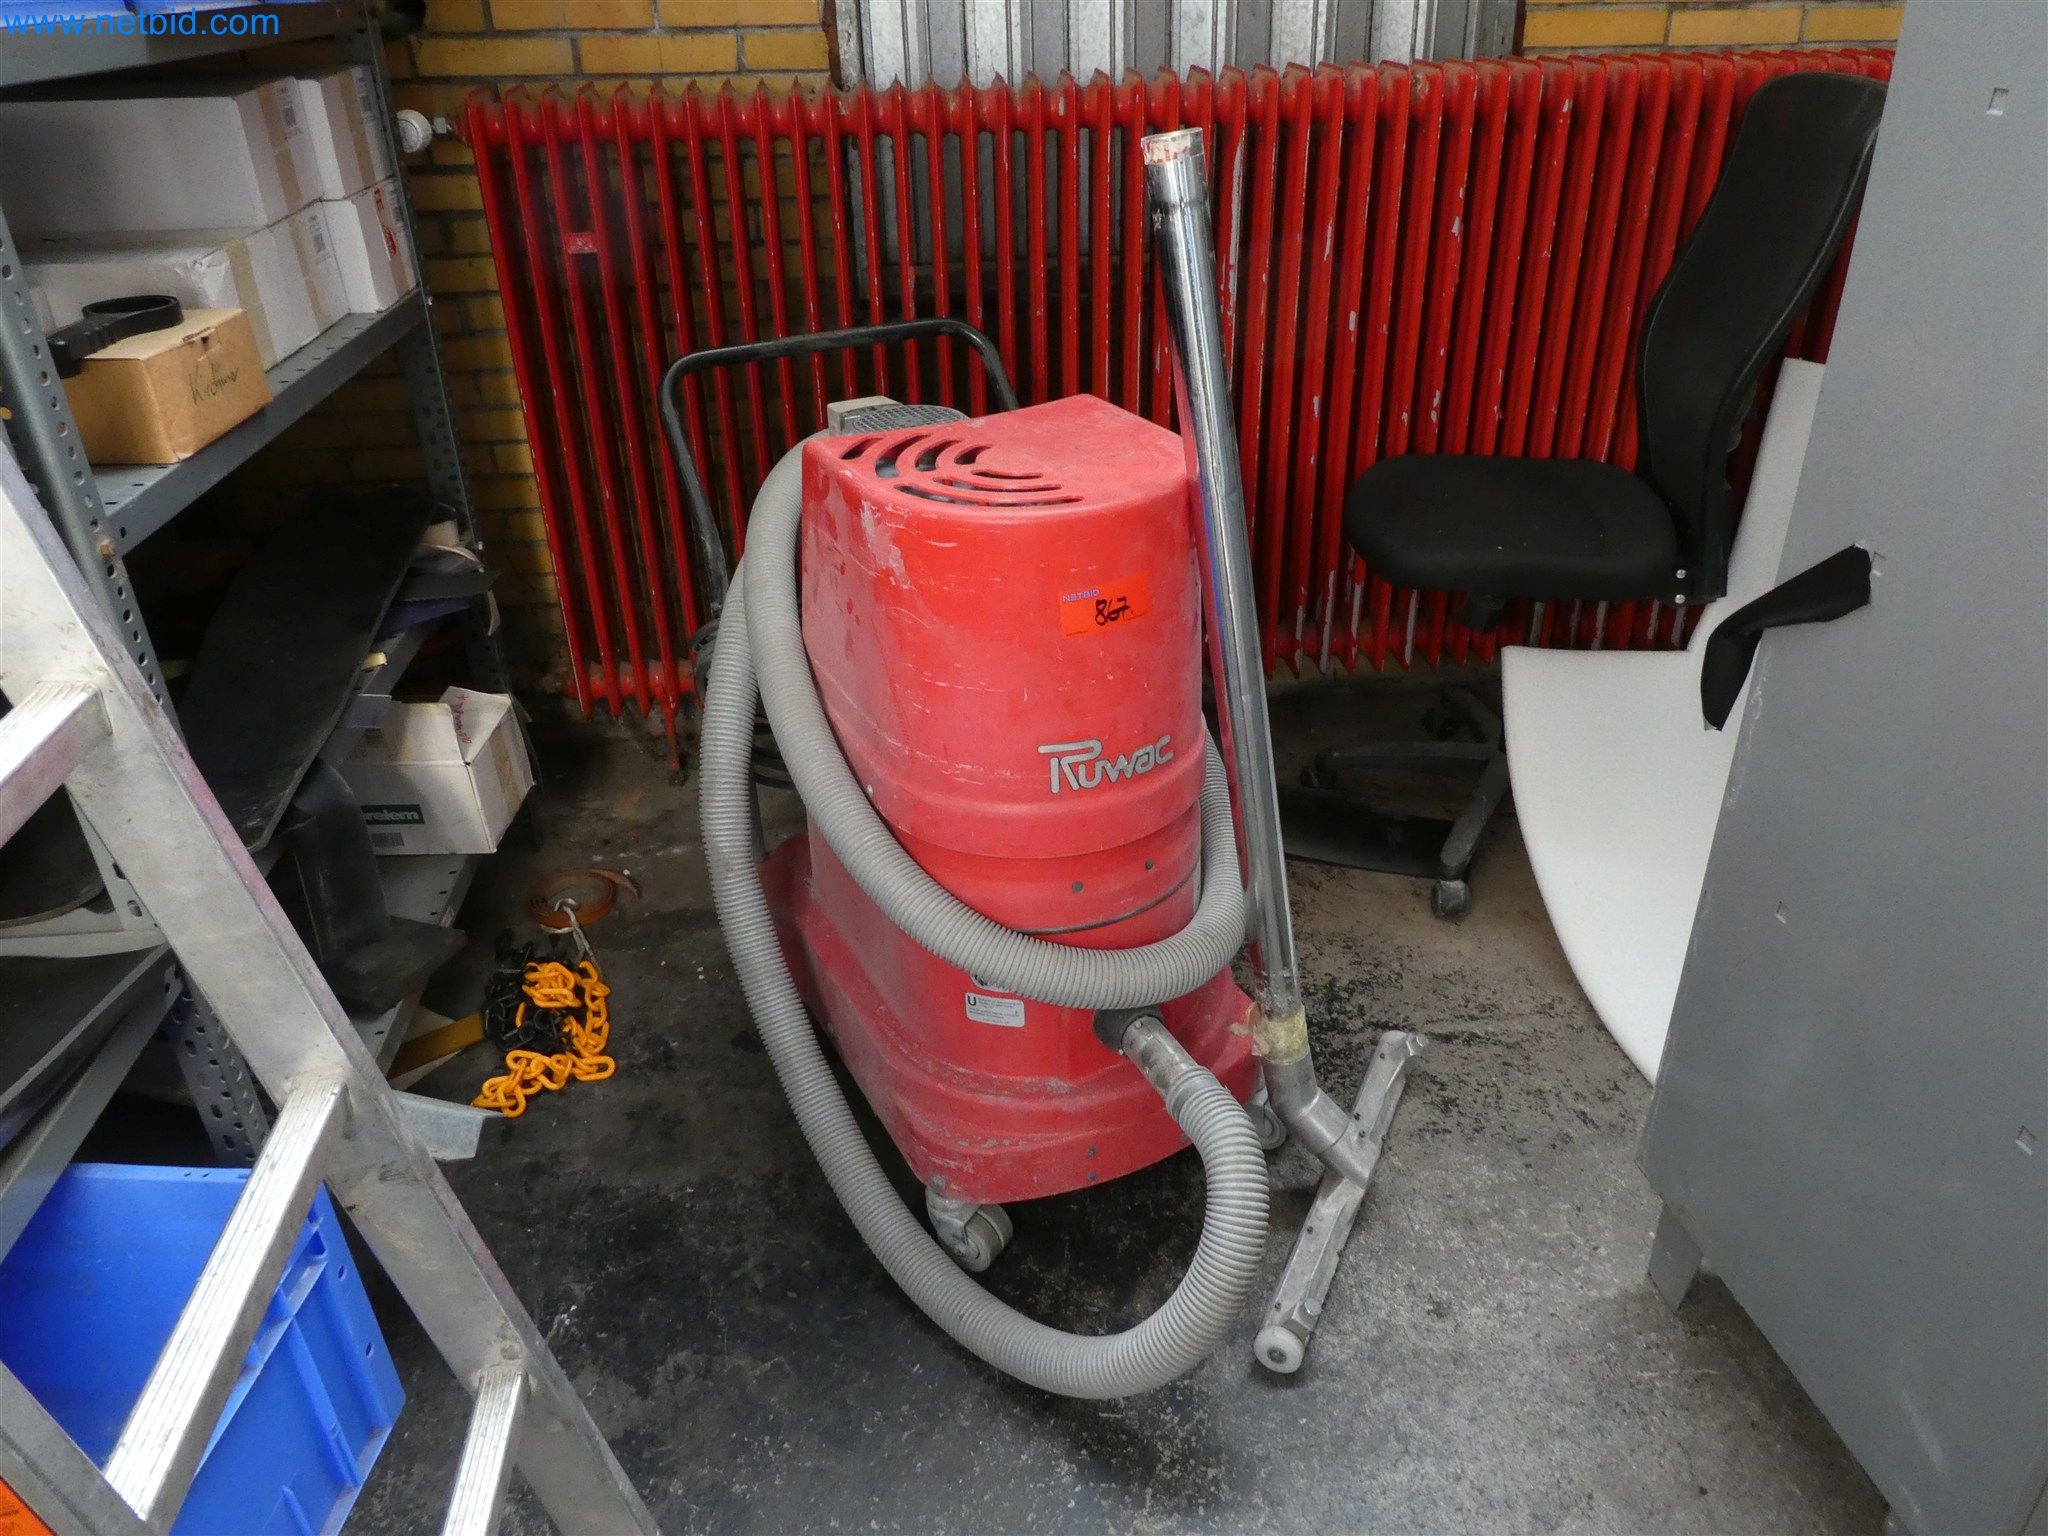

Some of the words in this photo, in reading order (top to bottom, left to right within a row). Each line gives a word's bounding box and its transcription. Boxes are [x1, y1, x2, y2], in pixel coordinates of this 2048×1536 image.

[1062, 588, 1101, 602] NETBID
[1038, 735, 1173, 793] Ruwac
[967, 995, 977, 1006] U
